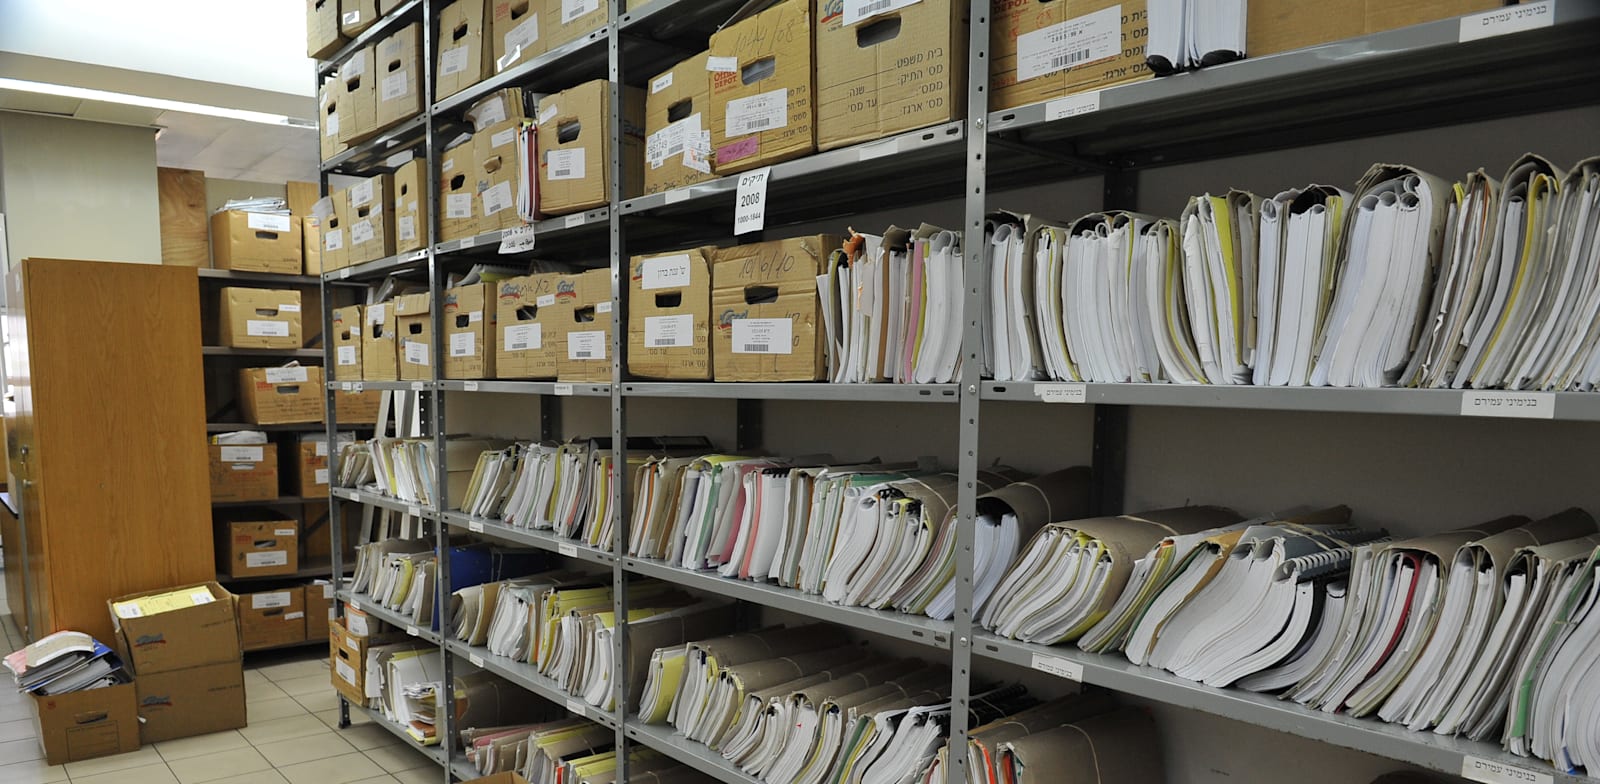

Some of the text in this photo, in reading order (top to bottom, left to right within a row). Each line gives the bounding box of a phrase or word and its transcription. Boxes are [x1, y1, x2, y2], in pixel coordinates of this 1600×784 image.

[1482, 4, 1546, 26] בנימיני עמירם
[928, 47, 942, 60] בית
[926, 64, 943, 75] מס'
[714, 76, 737, 88] DEPOT
[866, 98, 878, 108] עד
[742, 174, 764, 186] תיקים
[741, 192, 760, 207] 2008
[1474, 398, 1536, 406] בנימיני עמירם
[1475, 761, 1536, 782] בנימיני עמירם
